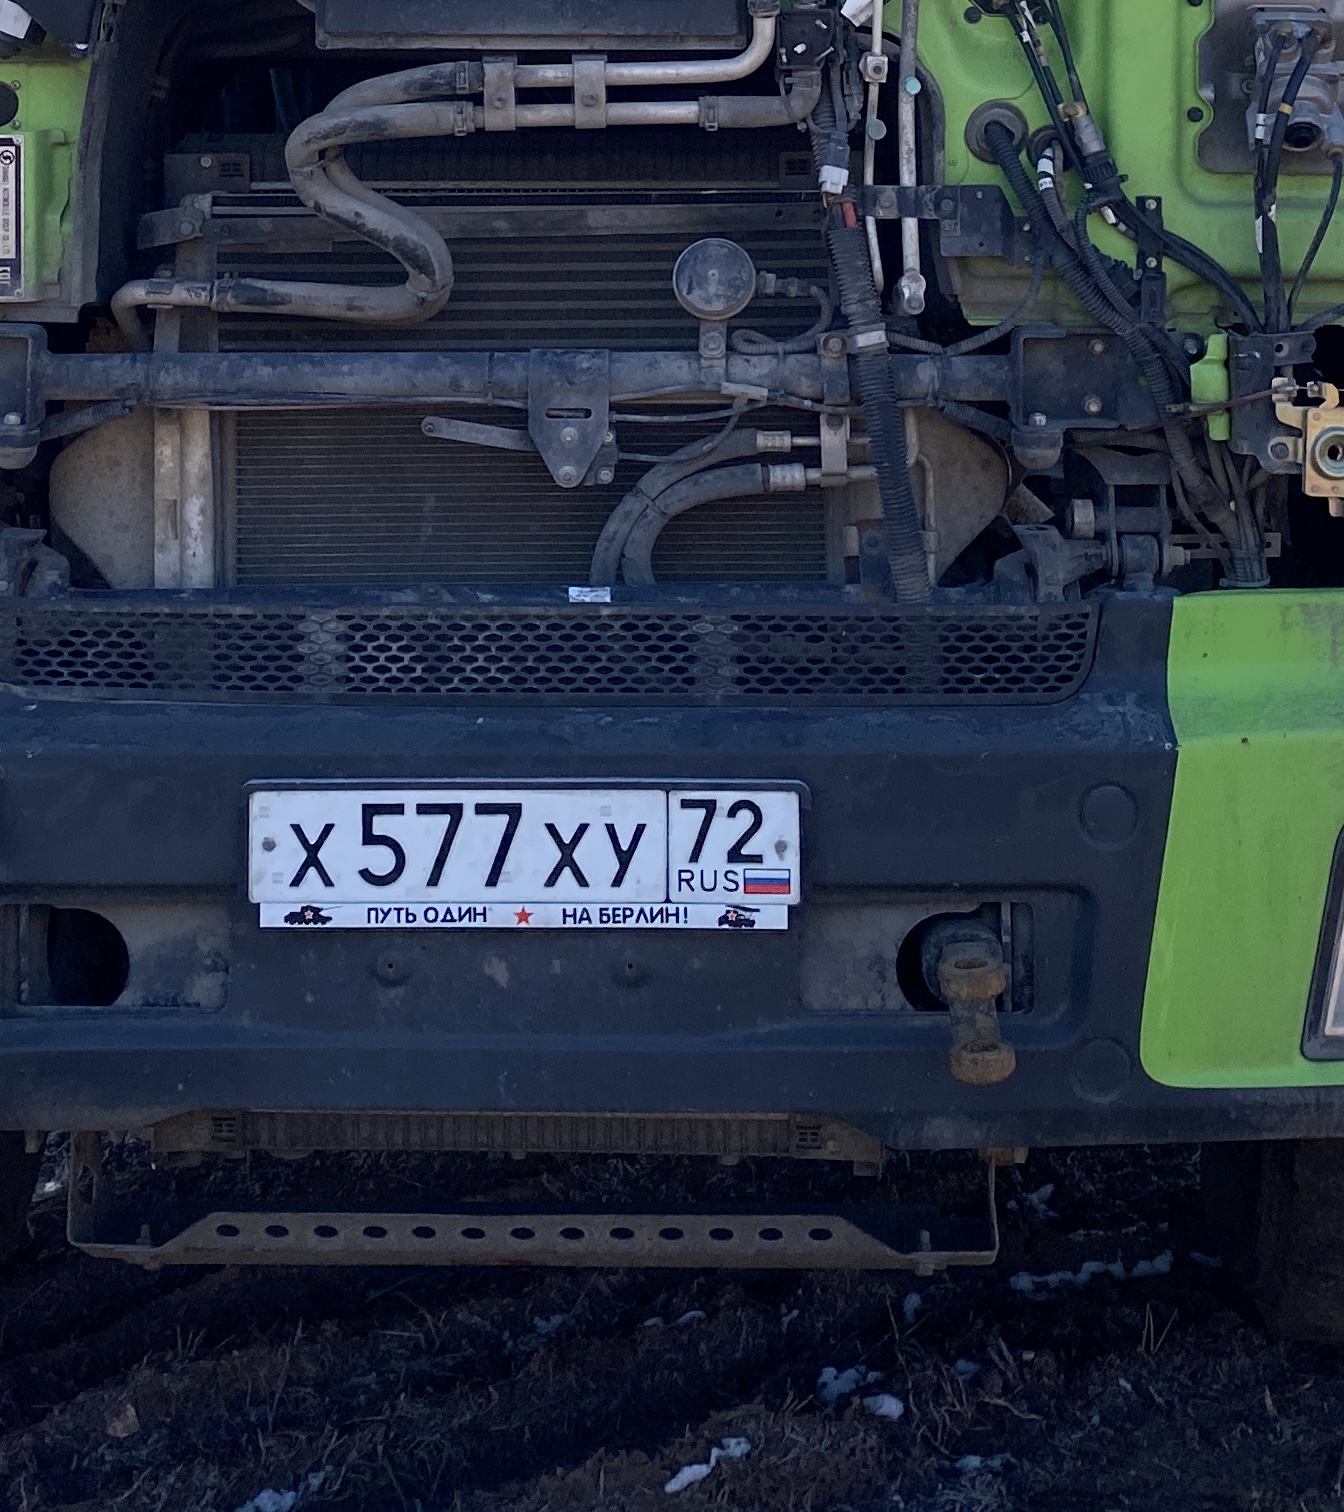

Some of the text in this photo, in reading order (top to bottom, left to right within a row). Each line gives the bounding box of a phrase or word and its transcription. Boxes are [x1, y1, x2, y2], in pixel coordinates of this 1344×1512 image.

[680, 798, 763, 864] 72
[677, 869, 740, 892] RUS
[366, 906, 688, 925] ПУТЬ ОДИН НА БЕРЛИН!
